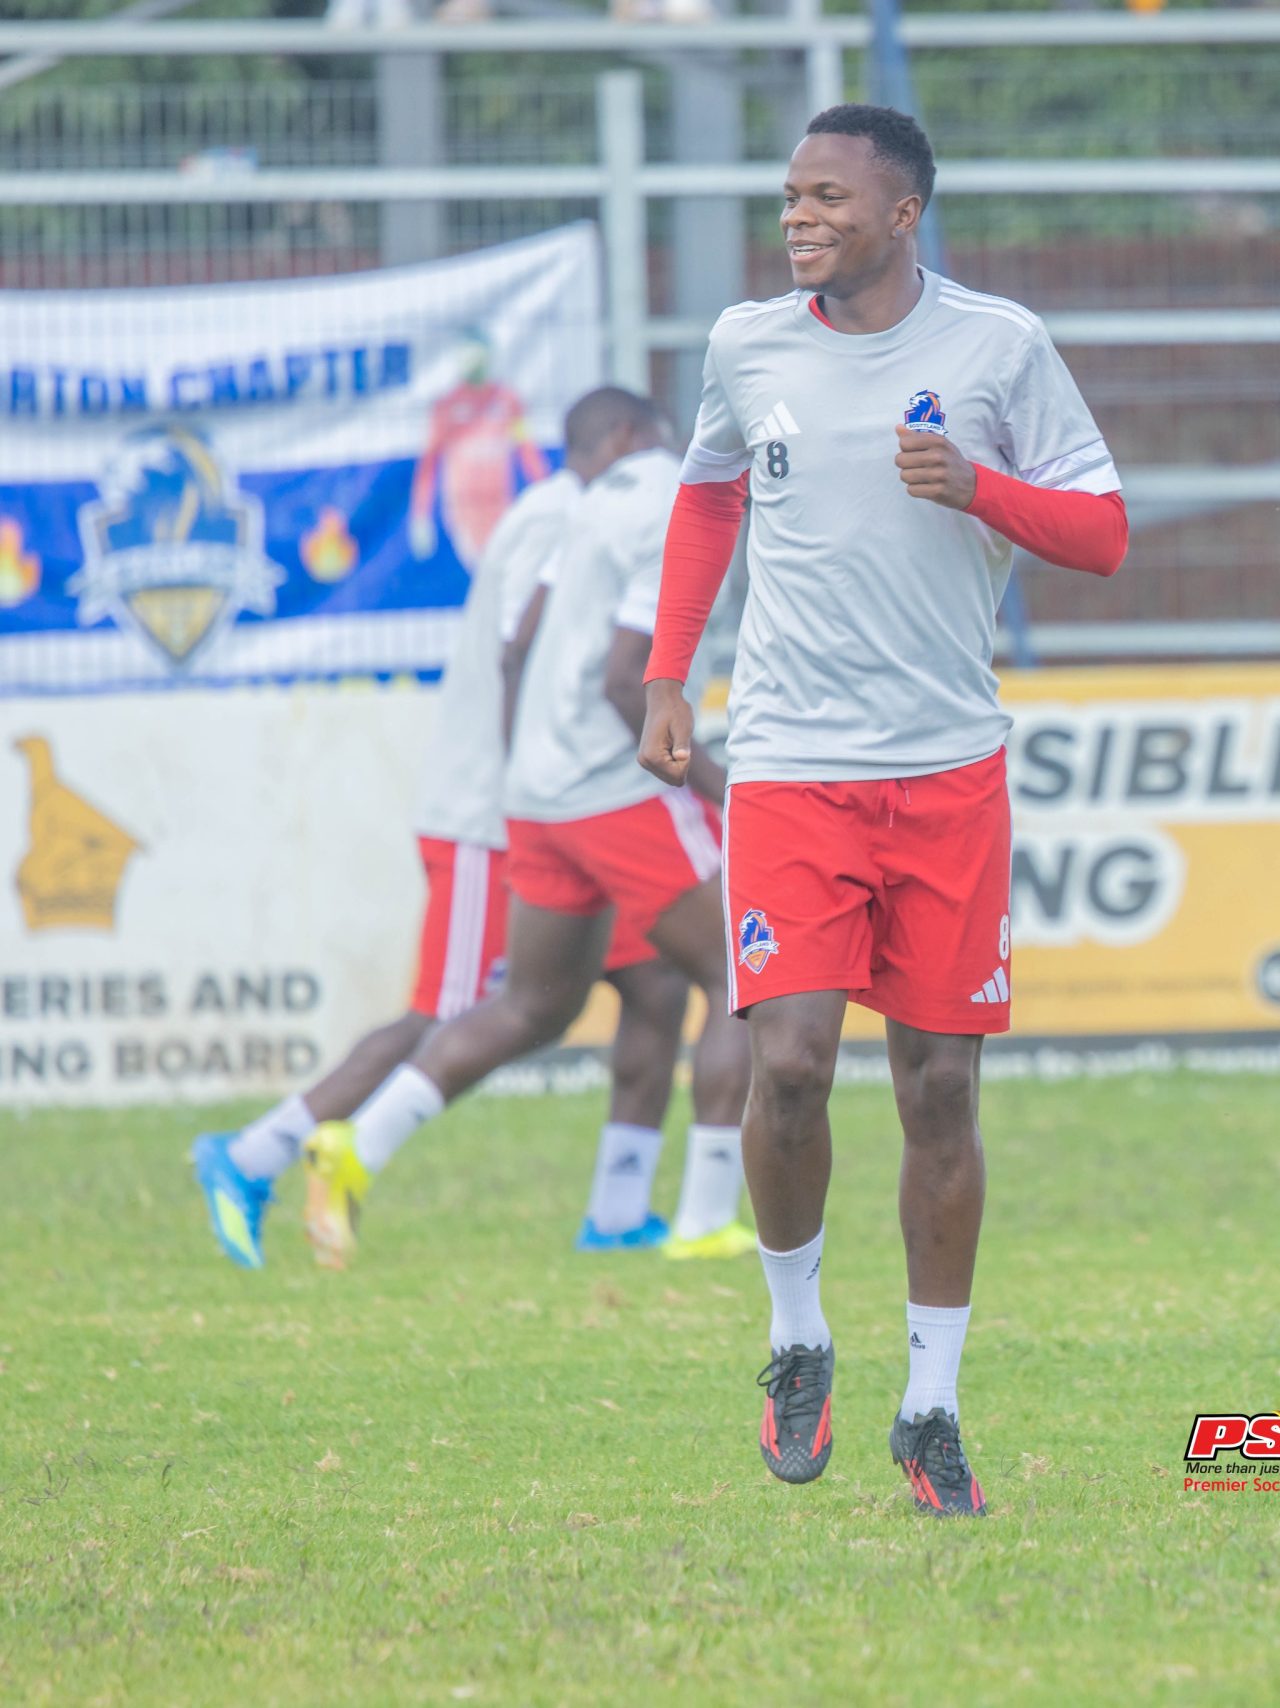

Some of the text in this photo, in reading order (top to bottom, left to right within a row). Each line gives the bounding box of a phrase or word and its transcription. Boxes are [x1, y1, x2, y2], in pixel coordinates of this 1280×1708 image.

[0, 342, 411, 418] RTON CHAPTER
[766, 440, 790, 480] 8
[998, 913, 1010, 961] 8
[2, 971, 321, 1017] ERIES AND
[113, 1035, 321, 1083] BOARD
